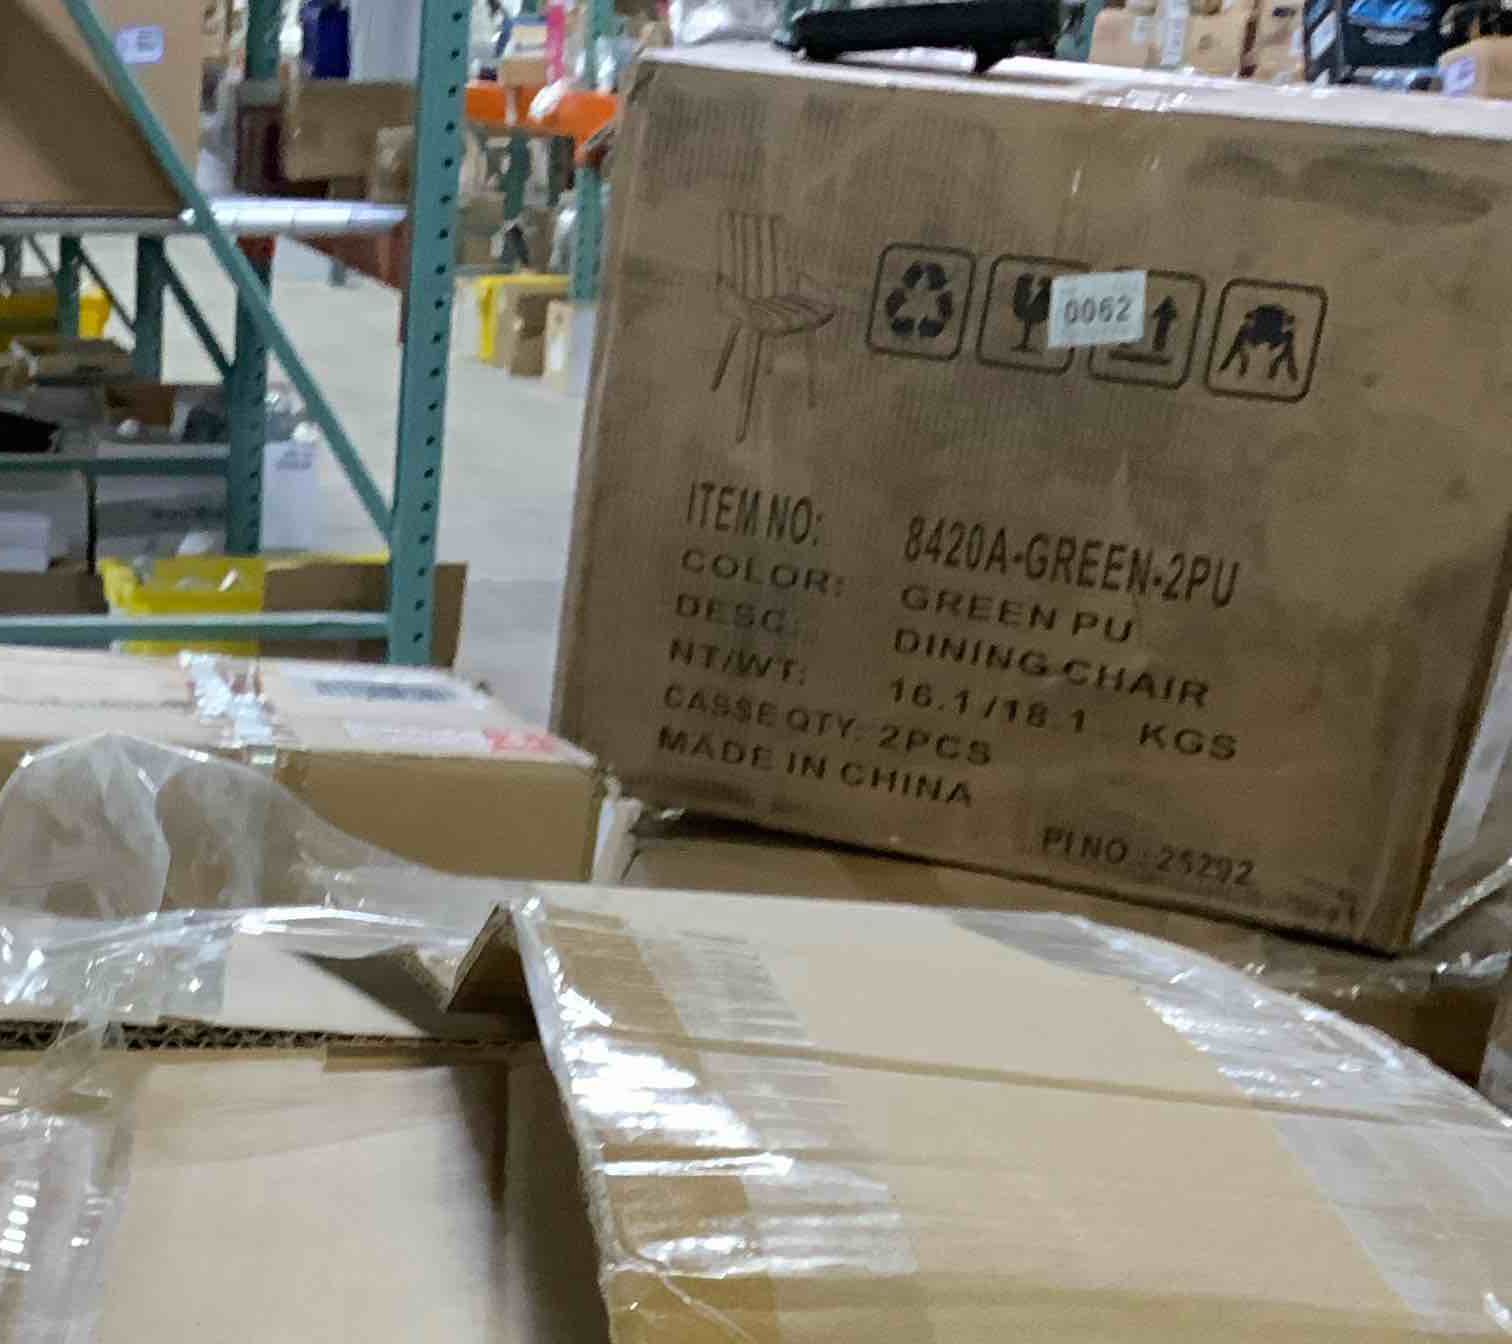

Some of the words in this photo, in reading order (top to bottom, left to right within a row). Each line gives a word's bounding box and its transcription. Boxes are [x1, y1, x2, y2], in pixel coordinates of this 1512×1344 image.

[687, 480, 760, 536] ITEM
[766, 493, 823, 546] NO:
[681, 549, 844, 598] COLOR:
[904, 515, 1240, 608] 8420A-GREEN-2PU
[900, 585, 1057, 631] GREEN
[1071, 611, 1135, 643] PU
[893, 627, 1049, 677] DINING
[1062, 659, 1209, 708] CHAIR
[663, 682, 775, 728] CASSE
[879, 724, 991, 766] 2PCS
[1139, 722, 1239, 761] KGS
[657, 724, 774, 771] MADE
[787, 751, 826, 780] IN
[840, 760, 972, 808] CHINA
